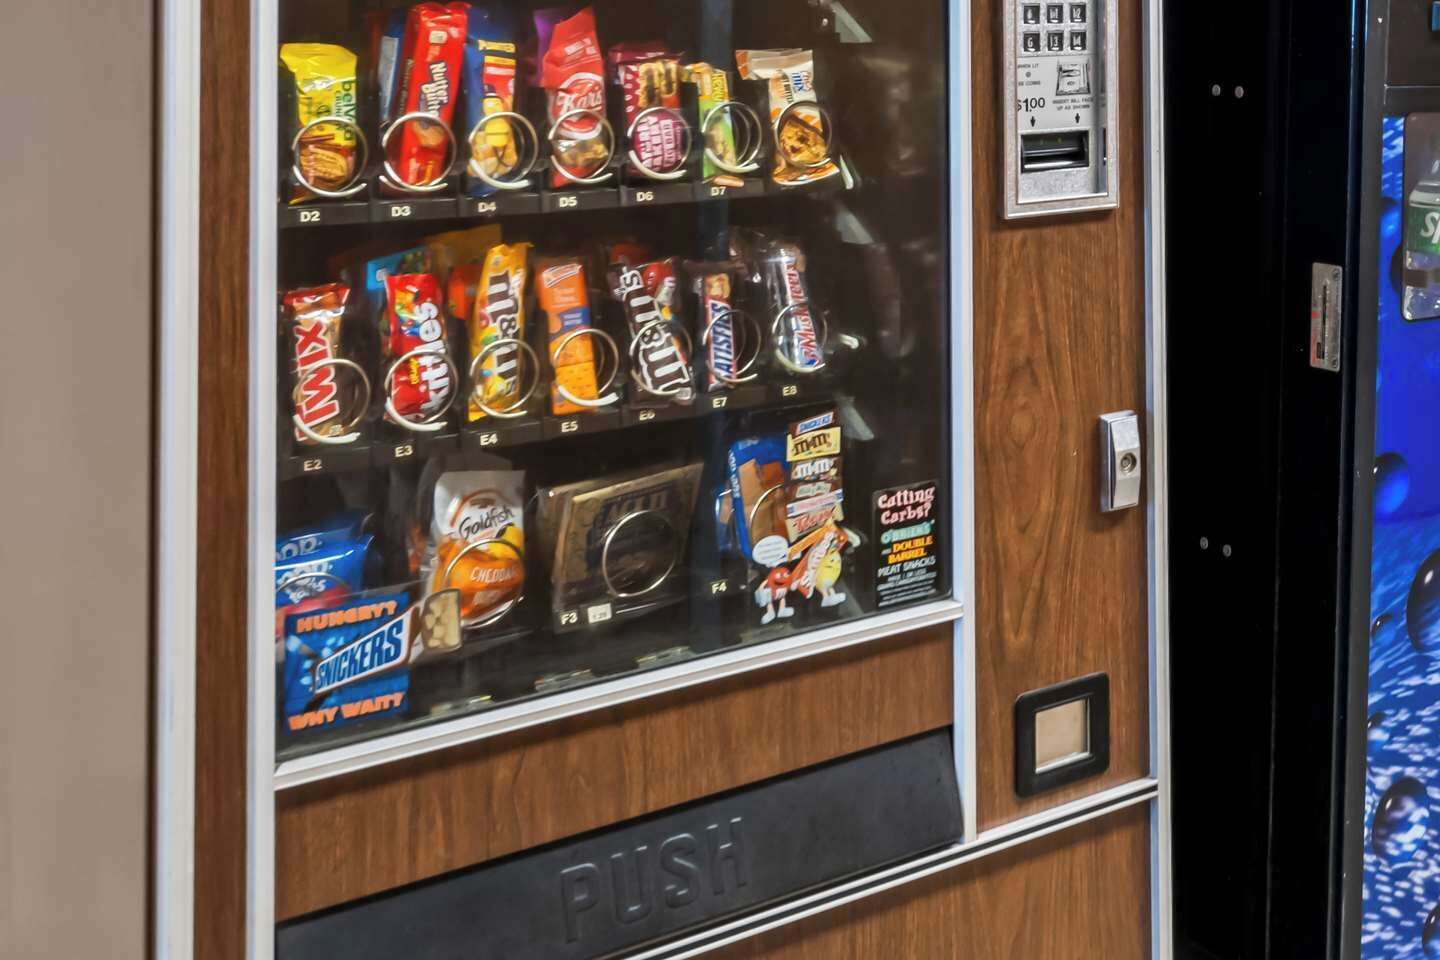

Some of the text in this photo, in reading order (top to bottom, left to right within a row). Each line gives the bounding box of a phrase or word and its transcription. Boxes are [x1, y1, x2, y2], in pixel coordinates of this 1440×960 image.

[636, 191, 653, 202] D6
[711, 186, 727, 197] D7
[477, 202, 496, 213] D4
[559, 196, 578, 207] D5
[300, 211, 321, 222] D2
[391, 206, 411, 217] D3
[413, 302, 450, 412] kittles
[713, 397, 727, 408] E7
[561, 421, 578, 432] E5
[480, 433, 498, 445] E4
[395, 446, 413, 458] E3
[303, 459, 322, 471] E2
[458, 505, 515, 540] Goldfish
[711, 581, 727, 594] F4
[296, 600, 398, 633] HUNGRY?
[560, 612, 578, 625] F3
[316, 618, 404, 688] SNICKERS
[288, 692, 407, 732] WHY WAIT?
[560, 816, 748, 944] PUSH
